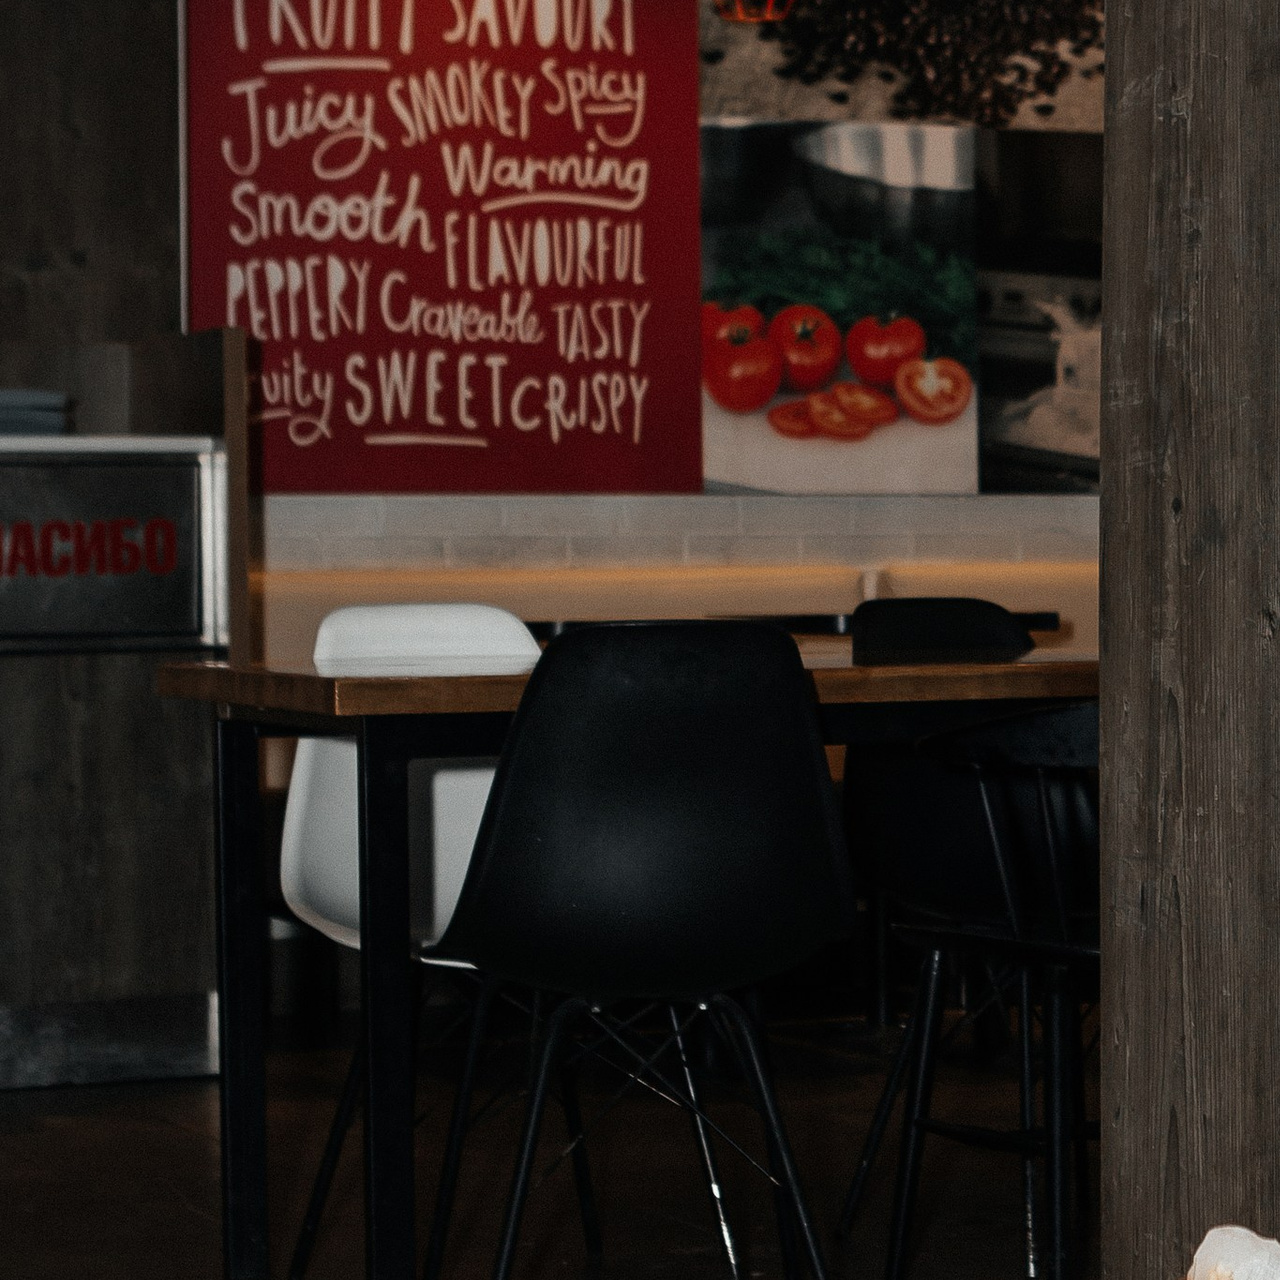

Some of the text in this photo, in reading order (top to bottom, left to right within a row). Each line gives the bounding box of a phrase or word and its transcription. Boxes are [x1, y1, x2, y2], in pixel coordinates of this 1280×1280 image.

[221, 58, 646, 181] Juicy SMOKEY Spicy
[229, 140, 650, 253] Smooth Warming
[226, 211, 645, 342] PEPPERY FLAVOURFUL
[380, 271, 652, 367] Craveable TASTY
[261, 347, 649, 448] uity SWEET CRISPY
[0, 517, 177, 577] АСИБО
